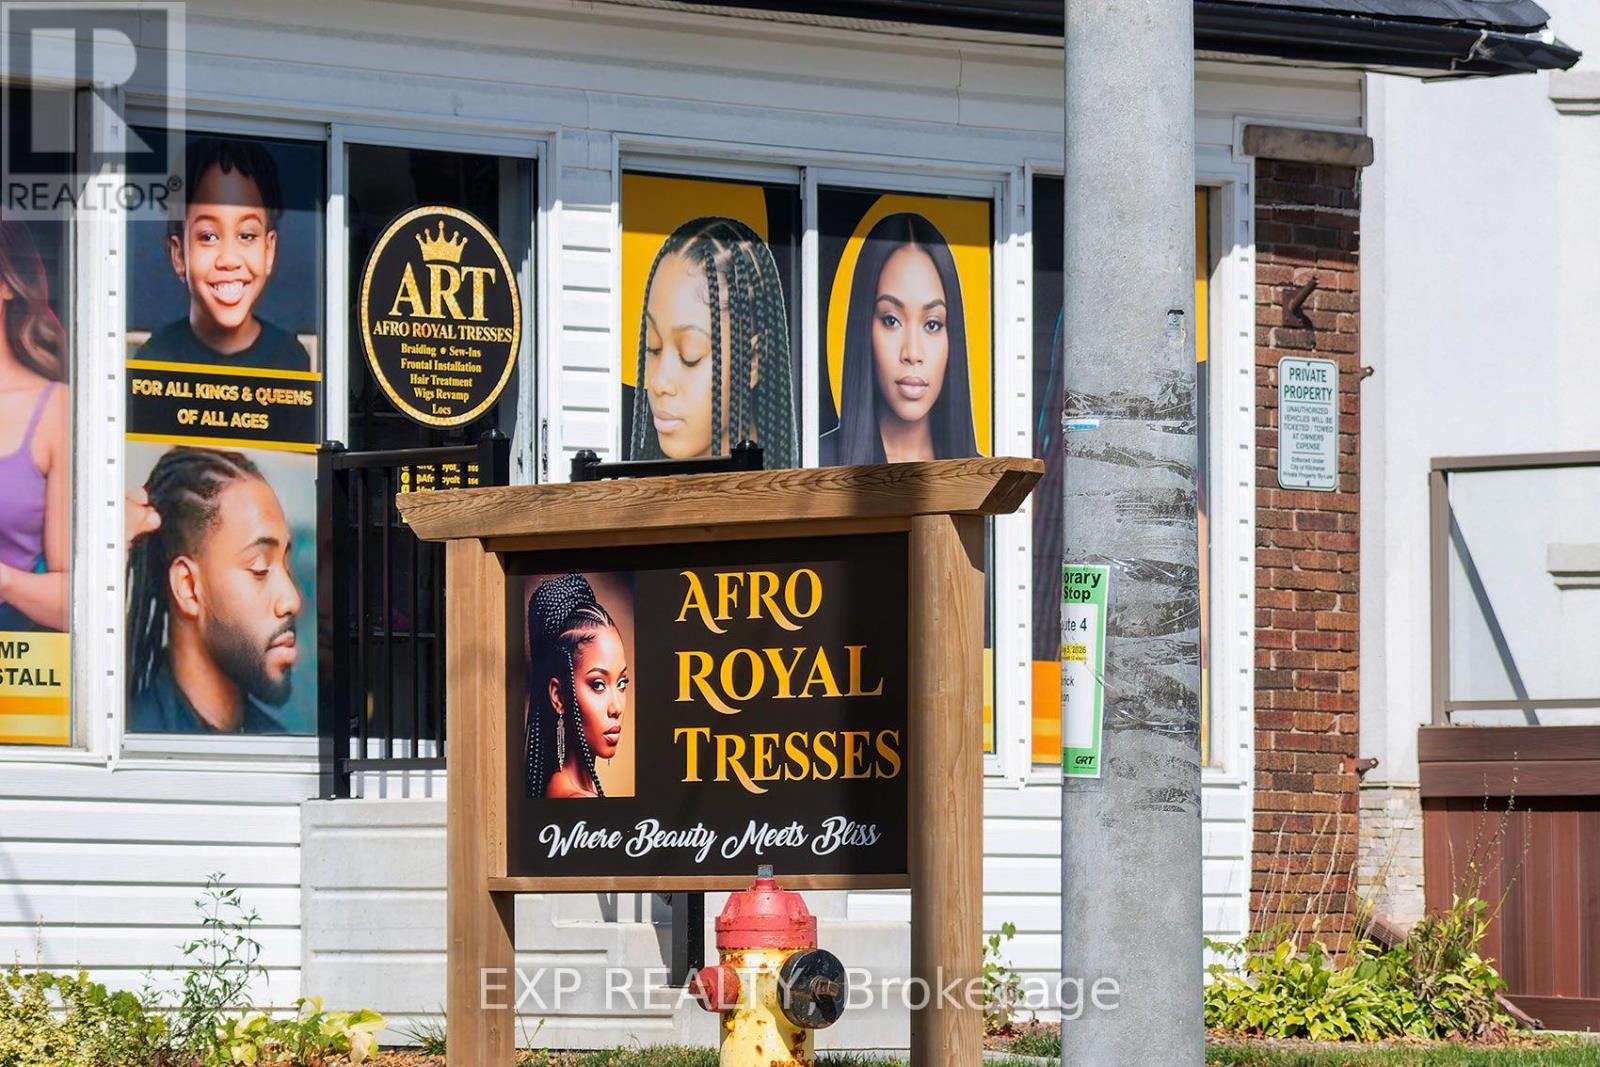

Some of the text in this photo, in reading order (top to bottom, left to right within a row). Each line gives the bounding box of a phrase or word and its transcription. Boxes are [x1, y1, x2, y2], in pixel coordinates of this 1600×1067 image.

[388, 262, 496, 322] ART
[373, 320, 513, 343] AFRO ROYAL TRESSES
[401, 344, 482, 358] Braiding Sew-Ins
[401, 358, 482, 373] Frontal Installation
[410, 373, 473, 388] Hair Treatment
[1289, 367, 1327, 383] PRIVATE
[132, 378, 313, 406] FOR ALL KINGS & QUEENS
[414, 388, 470, 403] Wigs Revamp
[1283, 385, 1333, 401] PROPERTY
[432, 404, 452, 415] Locs
[1286, 406, 1329, 415] UNAUTHORIZED
[177, 408, 270, 430] OF ALL AGES
[1284, 414, 1310, 423] VEHICLES
[1311, 416, 1324, 424] WILL
[1283, 424, 1310, 432] TICKETED
[1314, 425, 1334, 433] TOWED
[1292, 432, 1300, 440] AT
[1296, 442, 1321, 450] EXPENSE
[675, 568, 823, 634] AFRO
[1064, 586, 1091, 603] Stop
[1080, 618, 1088, 632] 4
[675, 645, 884, 715] ROYAL
[674, 727, 901, 794] TRESSES
[1075, 756, 1095, 764] GRT
[538, 816, 882, 863] Where Beauty Meets Bliss
